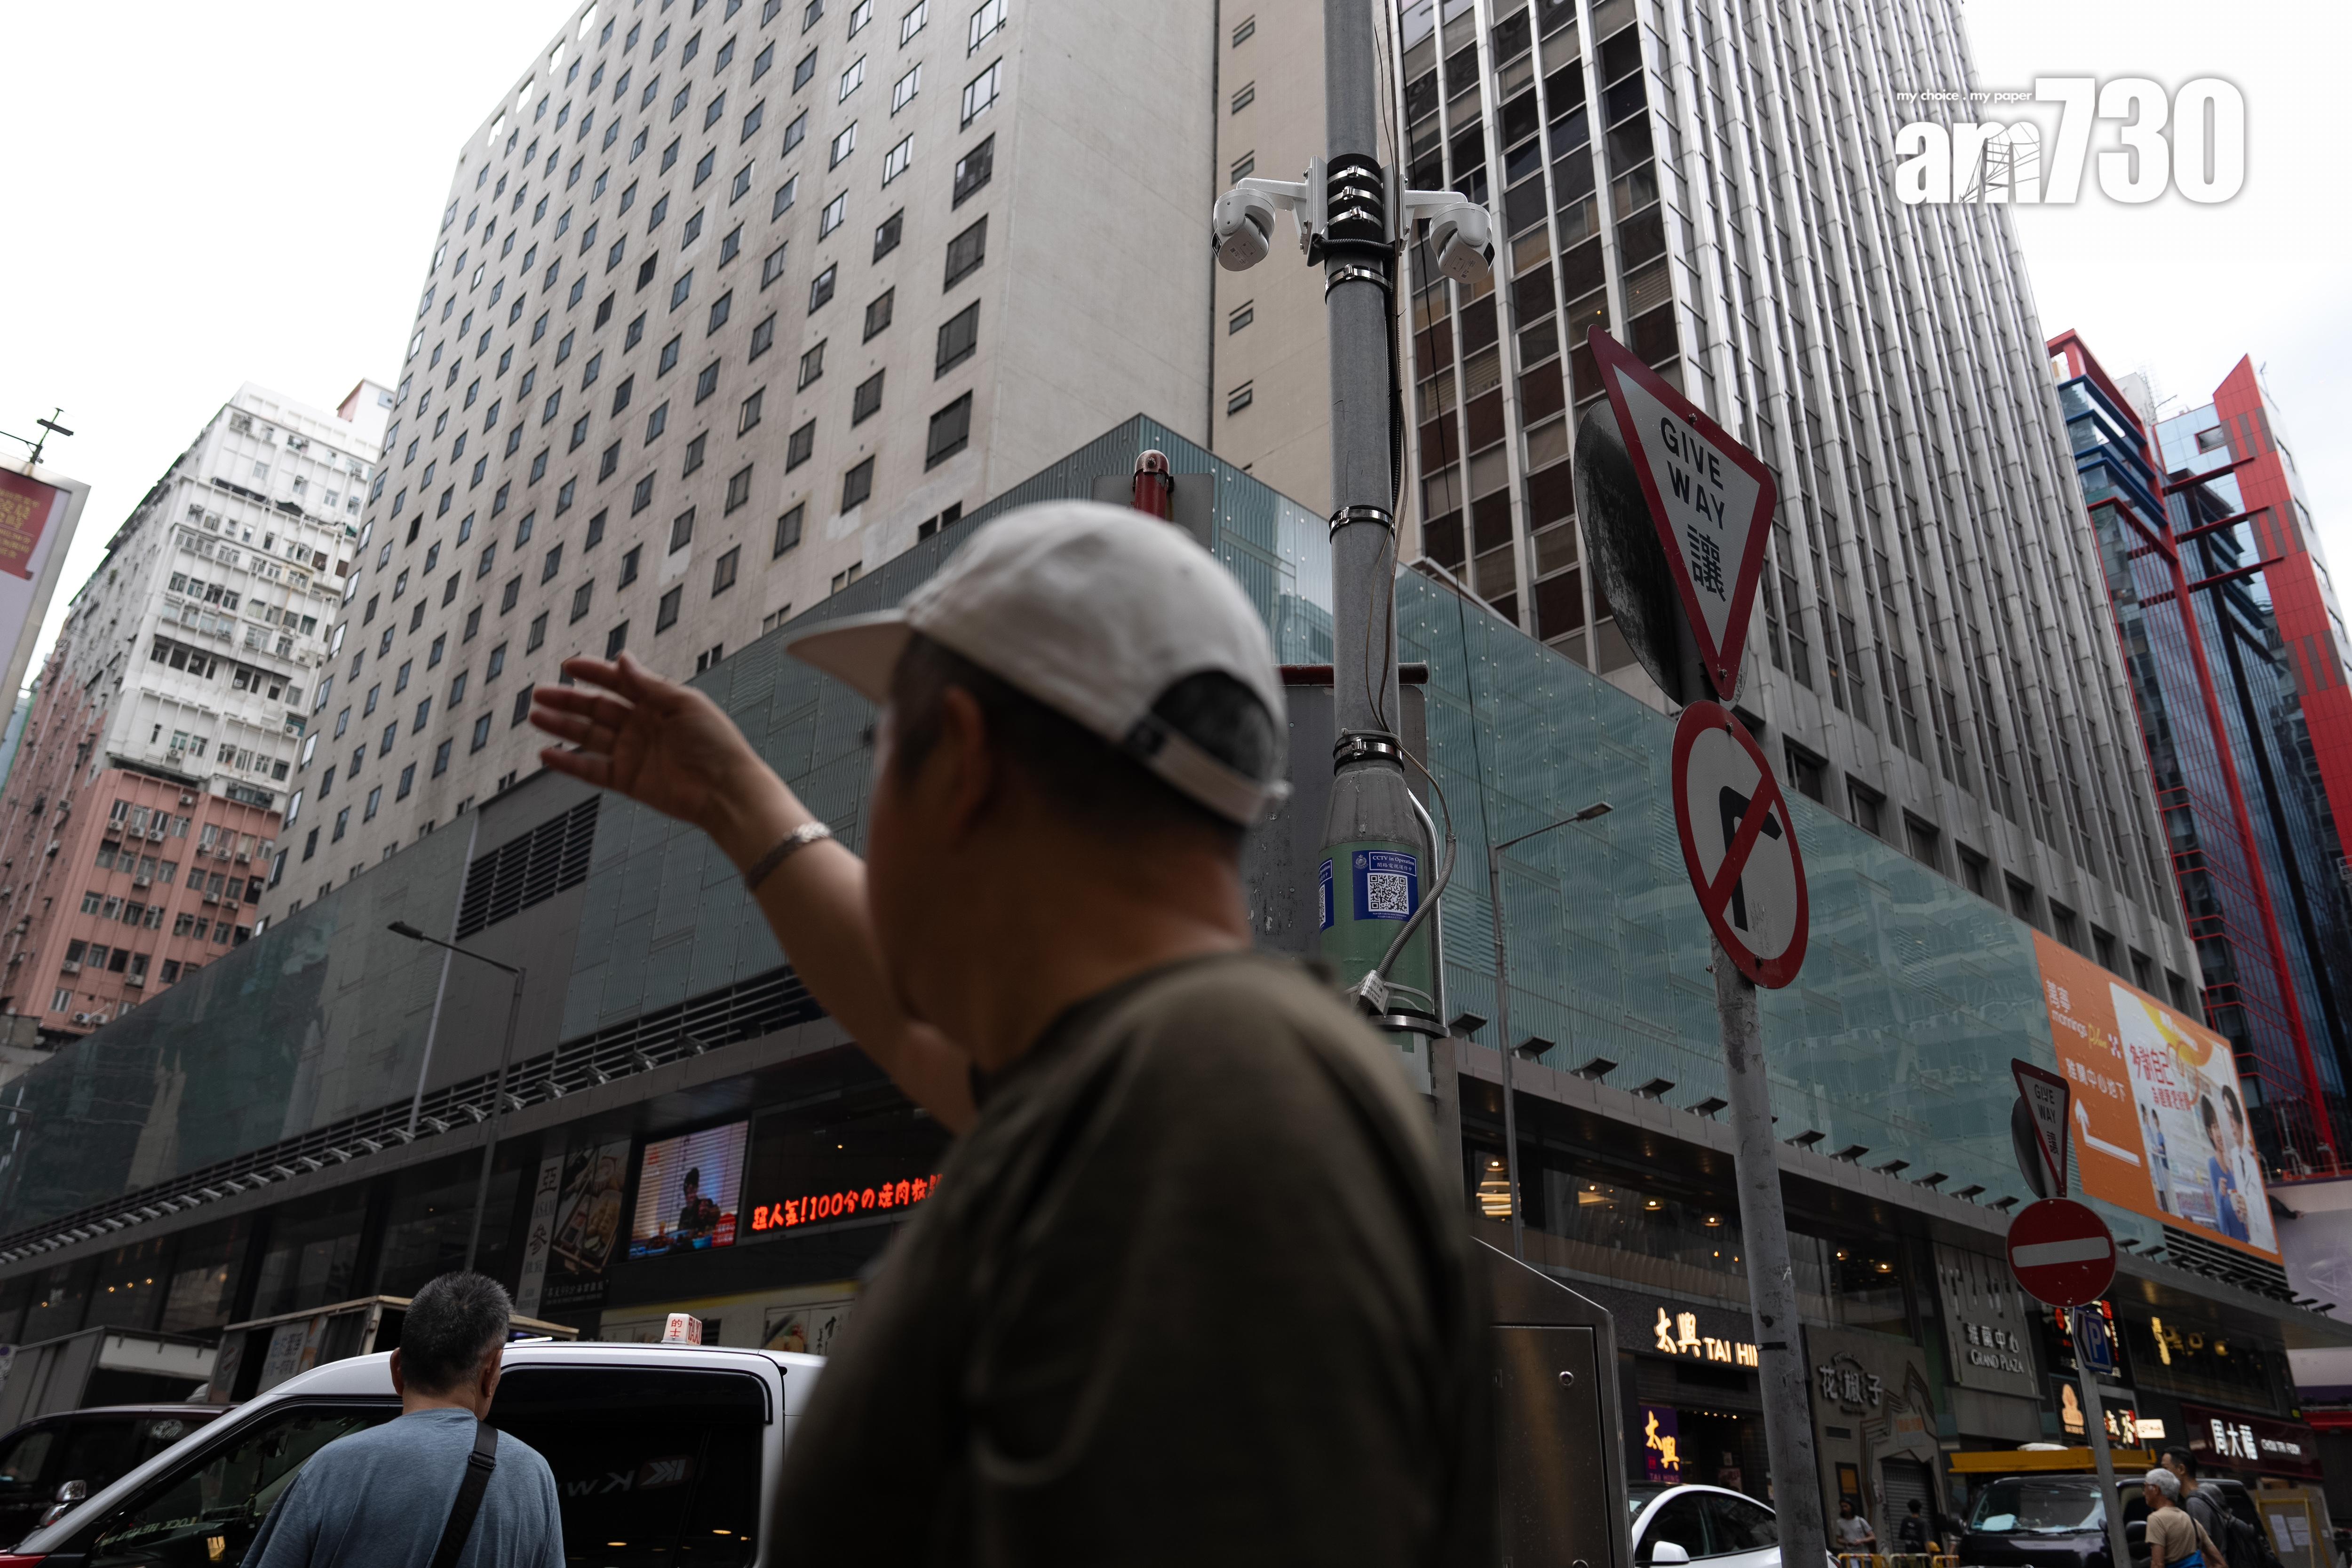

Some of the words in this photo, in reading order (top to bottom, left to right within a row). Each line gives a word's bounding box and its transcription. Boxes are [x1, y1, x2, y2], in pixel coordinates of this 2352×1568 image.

[1661, 417, 1724, 490] GIVE
[1667, 460, 1725, 530] WAY
[1687, 523, 1726, 602] 讓
[1394, 857, 1415, 866] Operation
[2034, 1084, 2054, 1105] GIVE
[2037, 1103, 2057, 1125] WAY
[670, 1319, 683, 1337] 的士
[688, 1317, 702, 1345] TAXI
[2088, 1321, 2103, 1359] P
[1702, 1337, 1732, 1363] TAI
[1970, 1350, 2000, 1370] GRAND
[2000, 1354, 2024, 1374] PLAZA
[2210, 1418, 2258, 1460] 周大福
